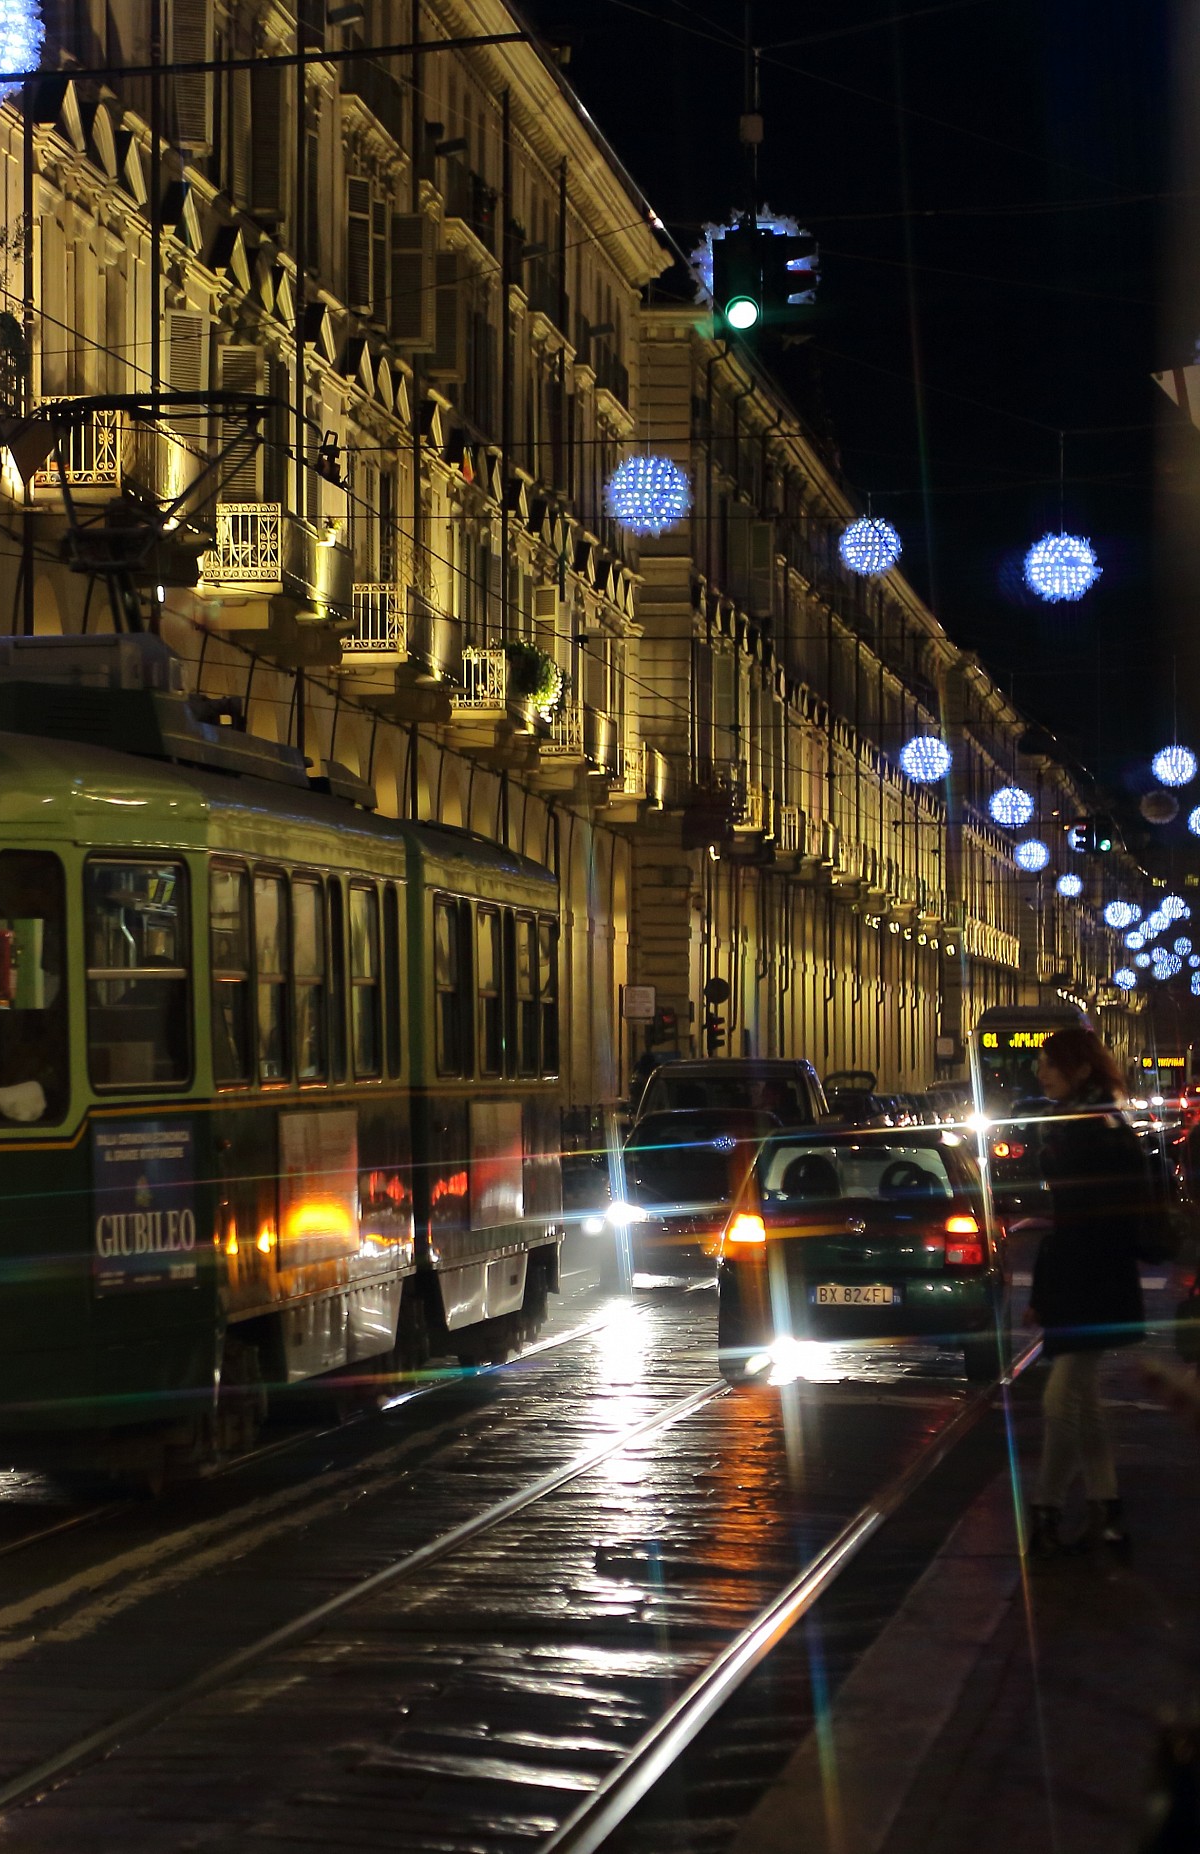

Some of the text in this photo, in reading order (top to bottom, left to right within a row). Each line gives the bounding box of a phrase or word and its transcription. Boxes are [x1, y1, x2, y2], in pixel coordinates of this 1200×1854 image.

[983, 1032, 999, 1048] 61
[96, 1209, 196, 1258] GIUBILEO
[819, 1287, 838, 1303] BX
[843, 1287, 892, 1303] 824FL
